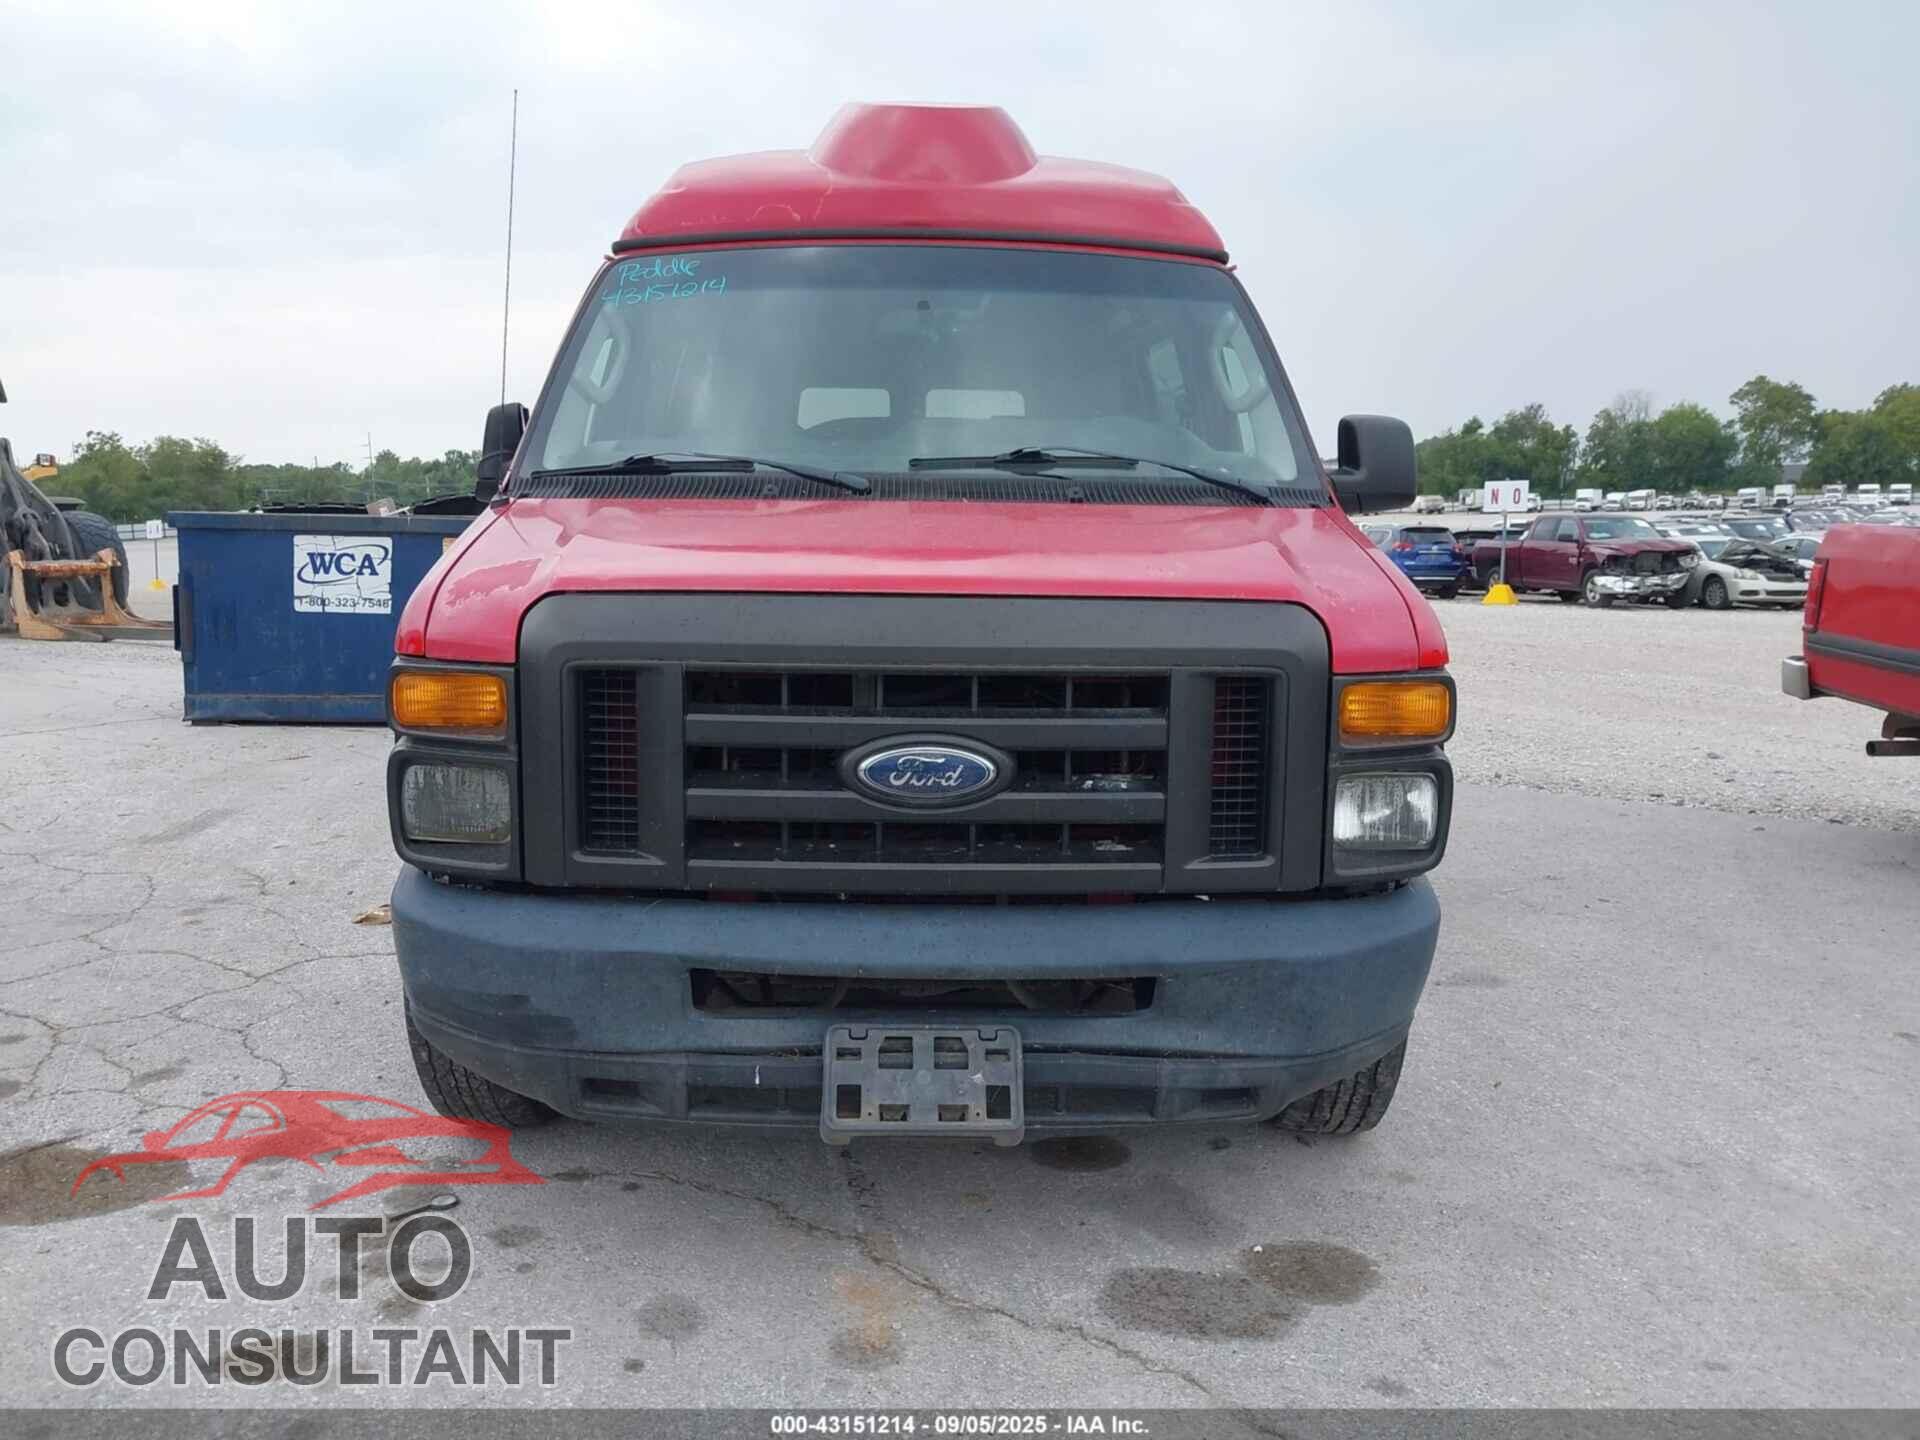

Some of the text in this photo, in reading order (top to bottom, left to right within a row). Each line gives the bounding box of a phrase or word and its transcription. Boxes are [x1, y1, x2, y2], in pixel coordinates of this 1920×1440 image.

[602, 275, 727, 307] 43151214
[306, 552, 379, 576] WCA
[889, 755, 964, 787] Ford
